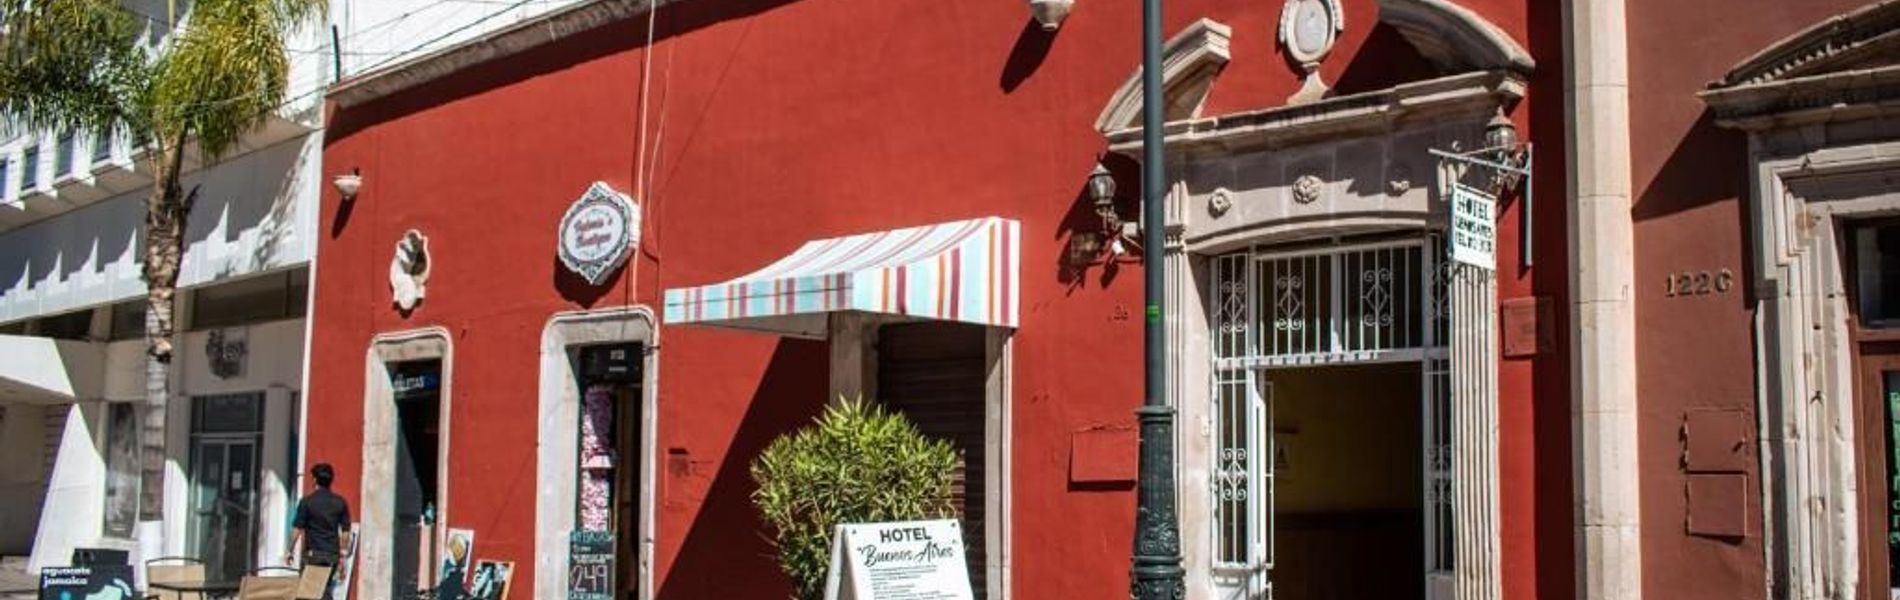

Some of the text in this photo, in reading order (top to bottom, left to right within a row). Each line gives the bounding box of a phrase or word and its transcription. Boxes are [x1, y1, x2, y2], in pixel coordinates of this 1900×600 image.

[1456, 193, 1489, 221] HOTEL
[879, 527, 932, 543] HOTEL
[43, 576, 88, 589] jamaica
